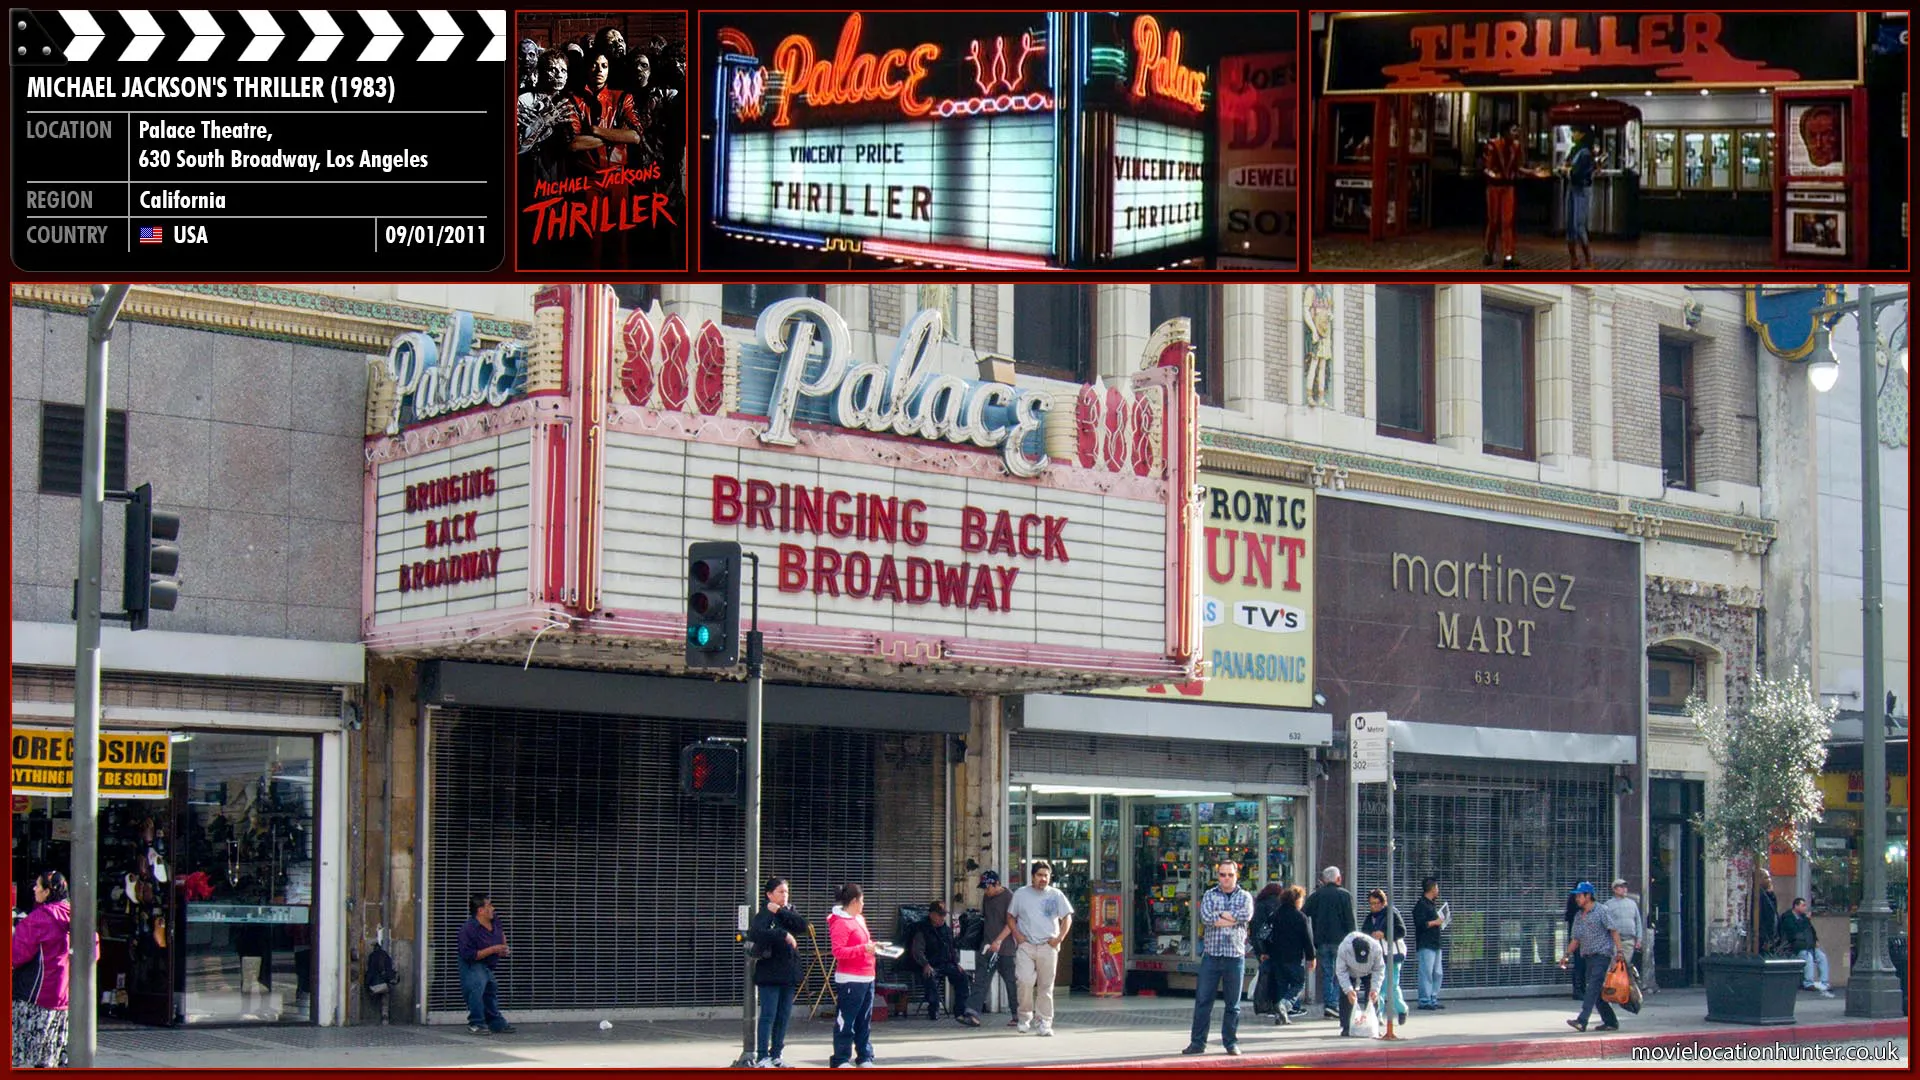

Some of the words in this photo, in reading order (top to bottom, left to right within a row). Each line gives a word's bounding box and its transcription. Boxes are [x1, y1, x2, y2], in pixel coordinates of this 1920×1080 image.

[1409, 14, 1728, 63] THRILLER
[772, 12, 941, 127] Palace
[789, 144, 845, 164] VINCENT
[855, 142, 905, 164] PRICE
[1115, 156, 1175, 182] VINCENT
[1177, 161, 1205, 182] PRIC
[533, 175, 592, 199] MICHAEL
[594, 160, 662, 189] JACKSON'S
[522, 191, 678, 245] THRILLER
[770, 180, 933, 222] THRILLER
[388, 311, 520, 436] Palace
[756, 297, 1055, 478] Palace
[405, 466, 496, 514] BRINGING
[425, 511, 479, 549] BACK
[712, 474, 928, 547] BRINGING
[961, 505, 1070, 562] BACK
[399, 547, 500, 592] BROADWAY
[778, 543, 1019, 613] BROADWAY
[1391, 551, 1576, 611] martinez
[1242, 606, 1298, 628] TV'S
[1437, 611, 1536, 656] MART
[1212, 649, 1306, 683] PANASONIC
[1475, 670, 1500, 685] 634
[66, 737, 166, 764] COSING
[1353, 741, 1358, 749] 2
[1353, 751, 1358, 759] 4
[105, 772, 121, 785] BE
[124, 773, 163, 786] SOLD!
[1352, 761, 1367, 770] 302
